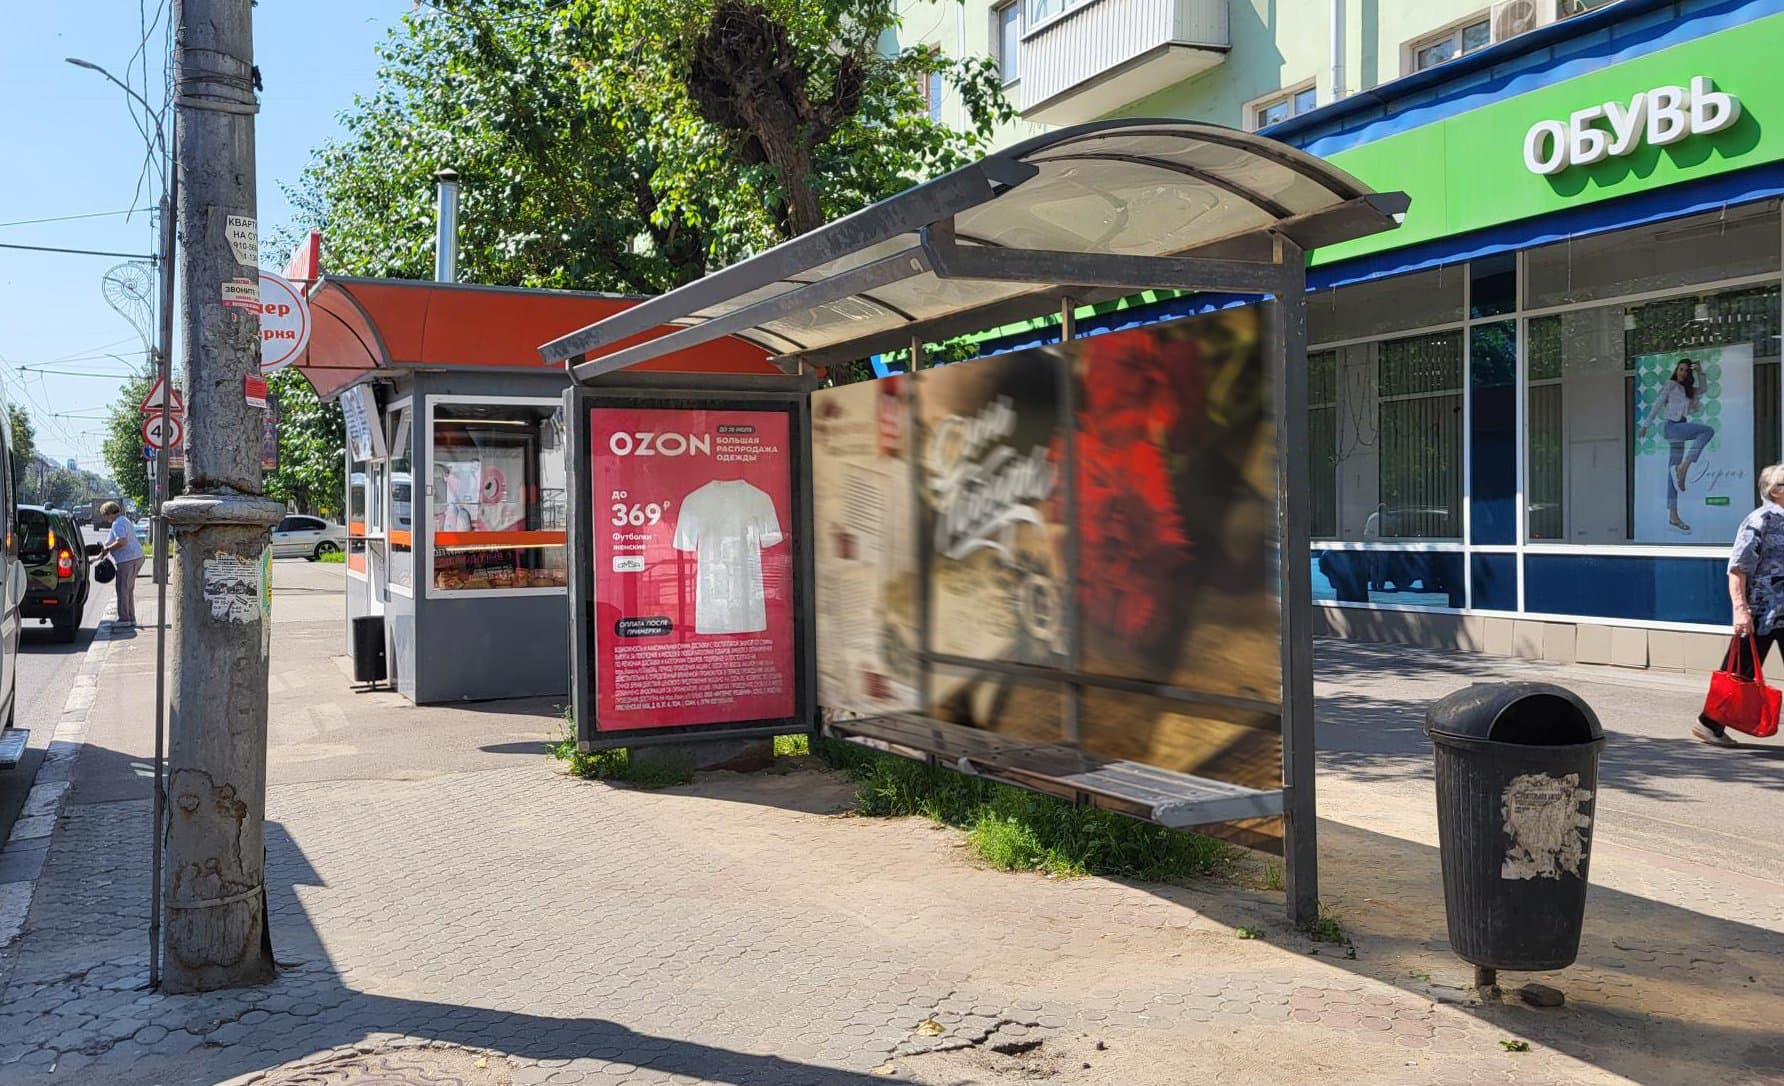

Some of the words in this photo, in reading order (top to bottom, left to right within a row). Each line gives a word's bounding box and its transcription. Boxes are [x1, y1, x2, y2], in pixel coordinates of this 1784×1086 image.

[1523, 76, 1740, 174] ОБУВЬ
[233, 230, 246, 240] НА
[224, 286, 256, 295] ЗВОНИТЕ
[609, 431, 711, 456] OZON
[716, 436, 760, 445] БОЛЬШАЯ
[716, 445, 778, 454] РАСПРОДАЖА
[716, 453, 757, 462] ОДЕЖДЫ
[612, 532, 652, 544] Футболки
